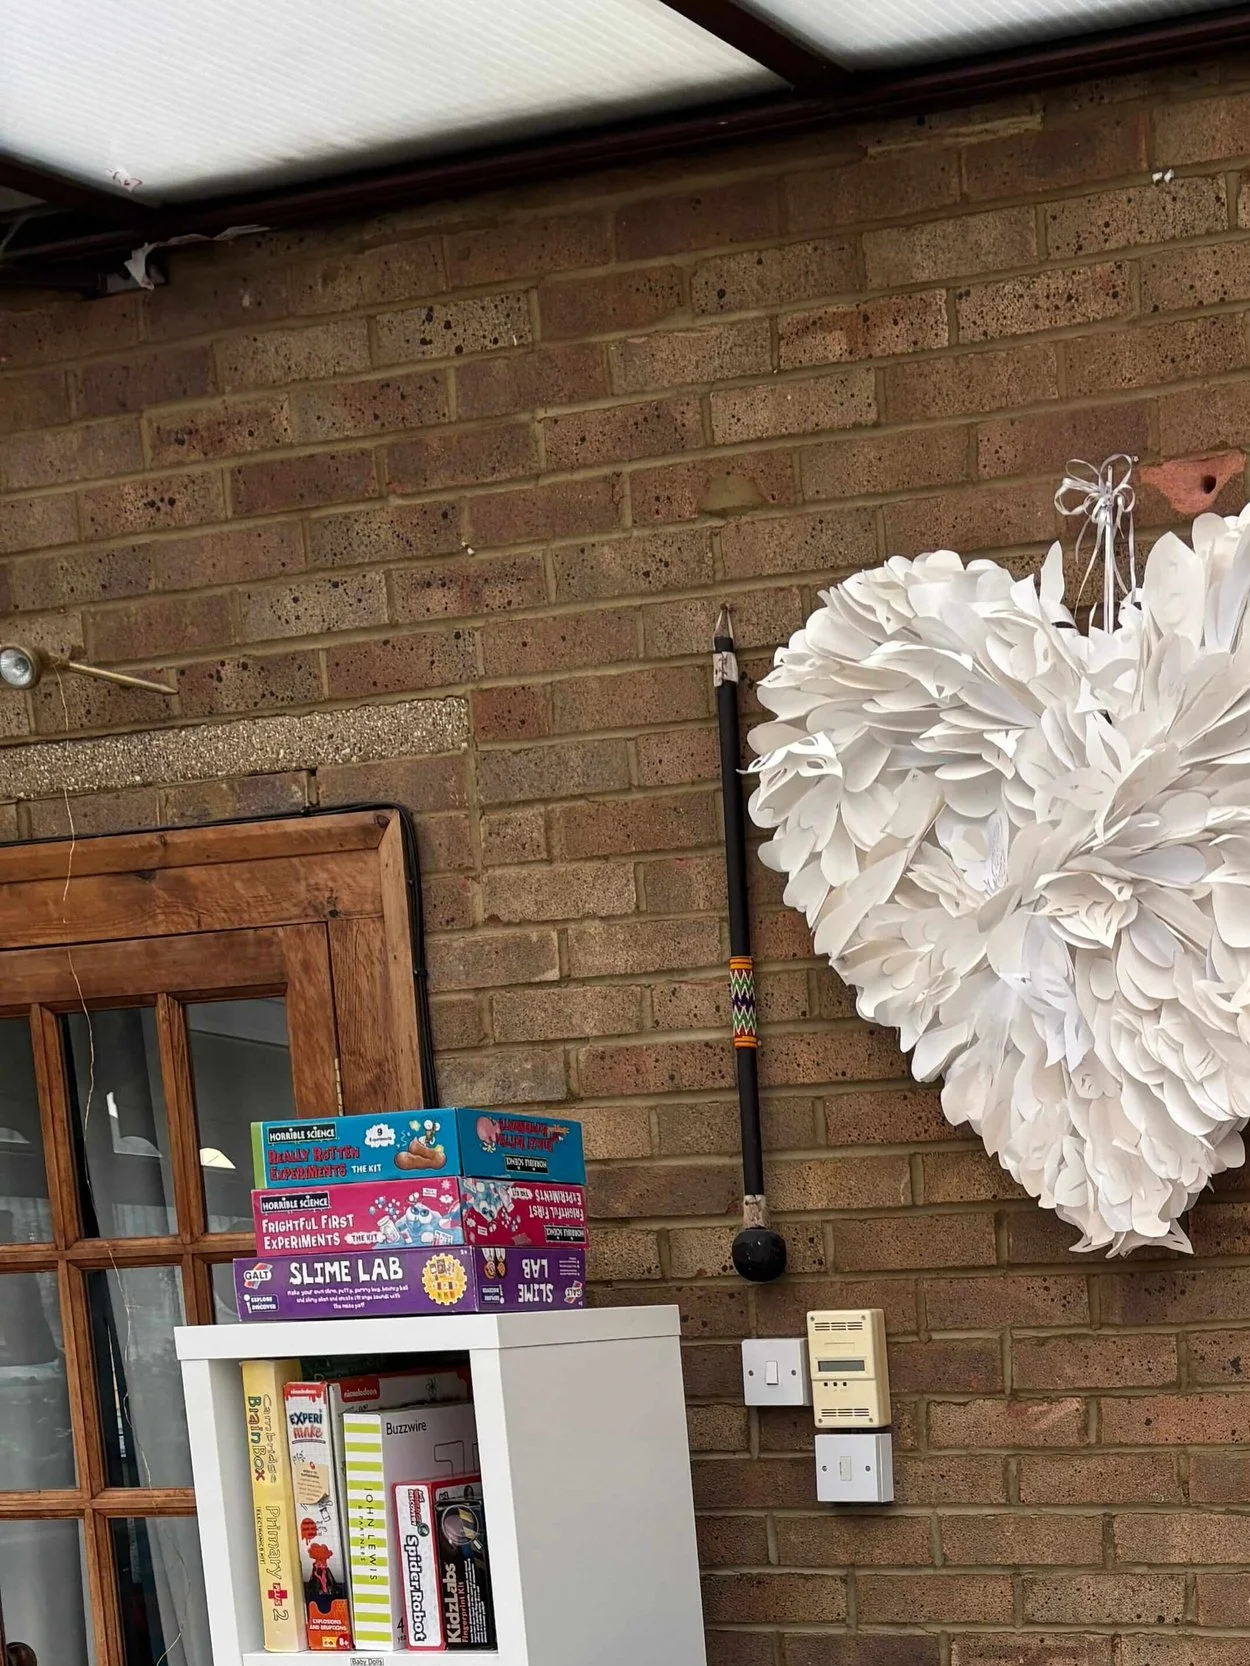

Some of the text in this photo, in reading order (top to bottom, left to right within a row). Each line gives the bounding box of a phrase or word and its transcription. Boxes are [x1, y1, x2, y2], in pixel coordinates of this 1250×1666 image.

[269, 1125, 336, 1142] HORRIBLE SCIENCE
[376, 1127, 383, 1136] 9
[269, 1163, 382, 1181] EXPERIMENTS THE KIT
[262, 1195, 328, 1212] HORRIBLE SCIENCE
[534, 1188, 583, 1206] EXPERIMENTS
[262, 1213, 354, 1234] FRIGHTFUL FIRST
[528, 1204, 584, 1222] FRIGHTFUL FIRST
[263, 1232, 378, 1250] EXPERIMENTS THE KIT
[244, 1269, 270, 1281] GALT
[289, 1256, 403, 1286] SLIME LAB
[521, 1258, 549, 1280] LAB
[517, 1282, 555, 1304] SLIME
[385, 1419, 428, 1436] Buzzwire
[247, 1395, 266, 1482] BrainBox
[262, 1393, 279, 1484] Cambridge
[364, 1487, 378, 1582] JOHN LEWIS
[265, 1504, 289, 1622] Primary PLUS 2
[404, 1534, 428, 1643] Spider Robot
[442, 1562, 462, 1643] KidzLabs
[457, 1580, 470, 1643] Fingerprint Kit
[351, 1657, 367, 1666] Baby
